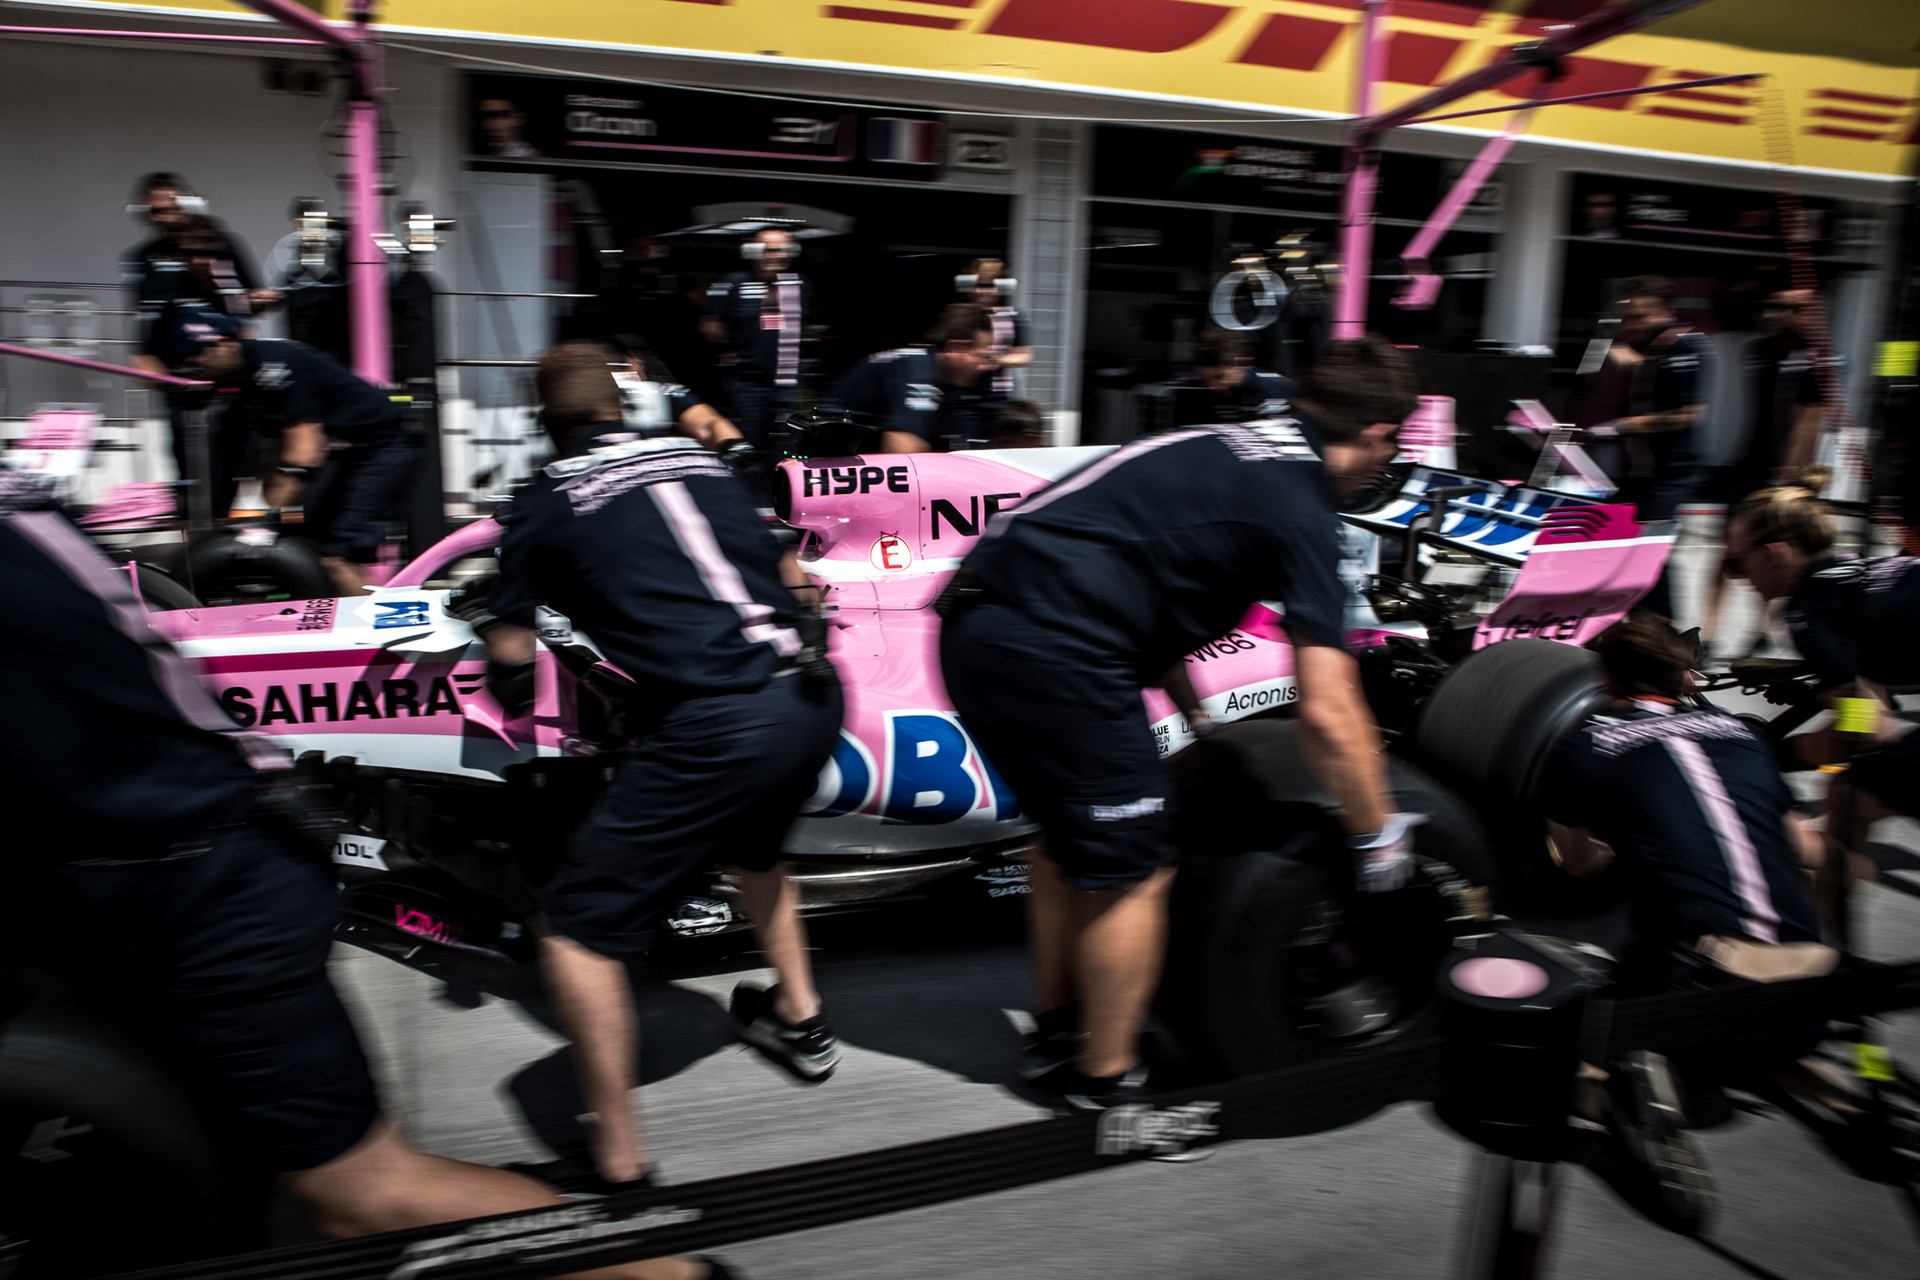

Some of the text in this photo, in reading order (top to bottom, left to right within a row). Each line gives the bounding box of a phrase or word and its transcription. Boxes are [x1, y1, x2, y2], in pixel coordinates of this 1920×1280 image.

[802, 466, 910, 497] HYPE
[880, 540, 903, 570] E
[1184, 632, 1256, 663] W66
[221, 676, 464, 728] SAHARA
[1225, 685, 1298, 715] Acronis
[1151, 725, 1170, 737] LUE
